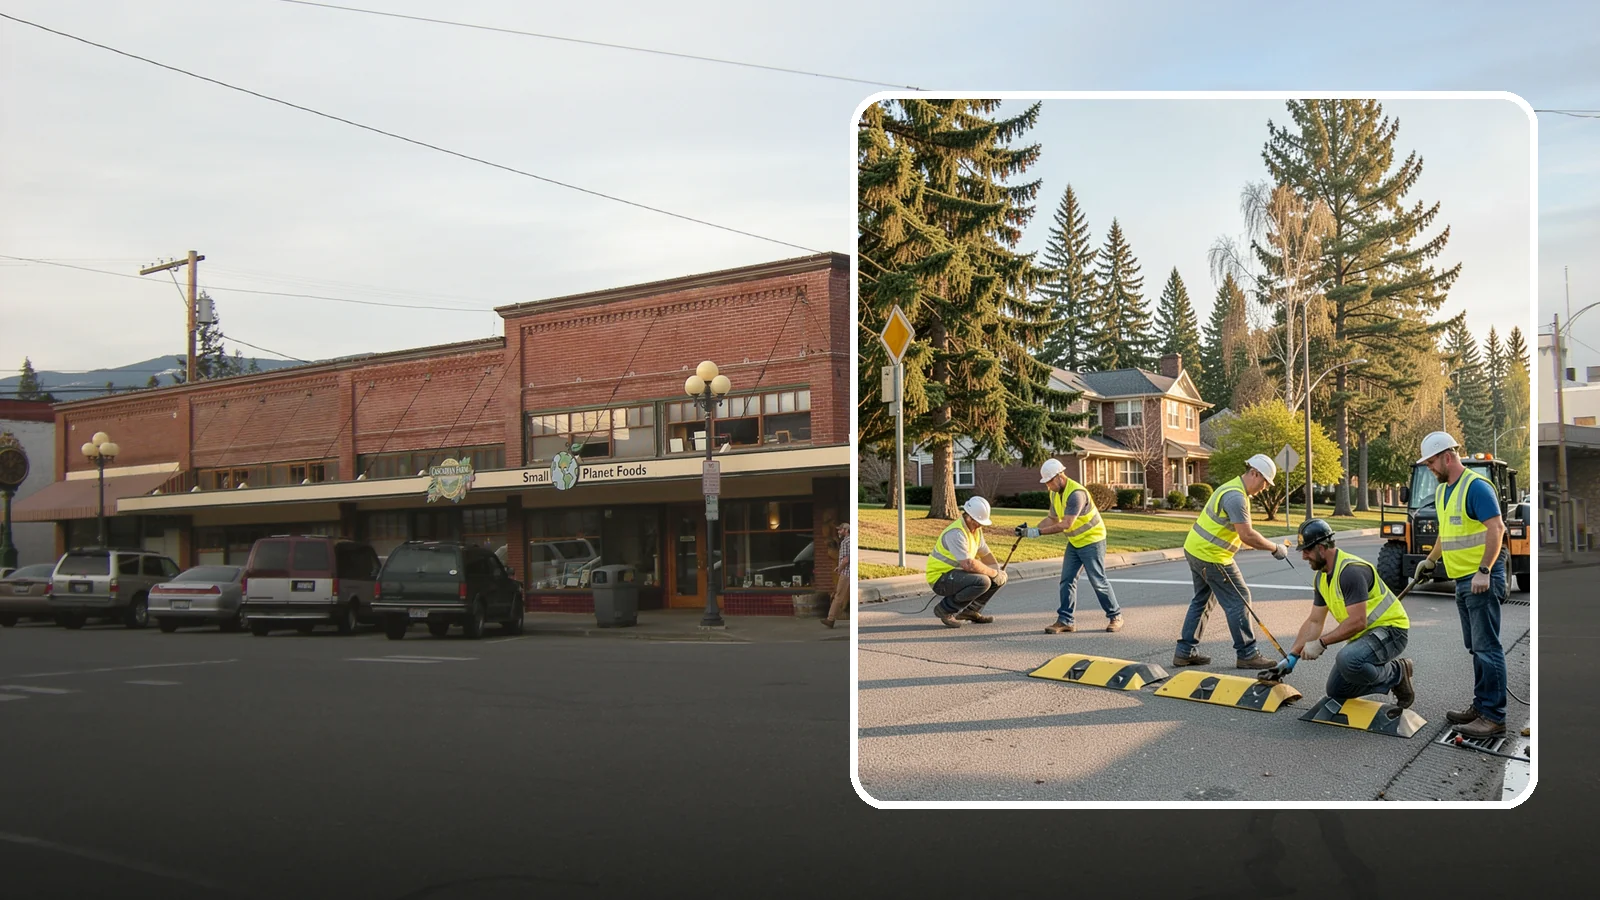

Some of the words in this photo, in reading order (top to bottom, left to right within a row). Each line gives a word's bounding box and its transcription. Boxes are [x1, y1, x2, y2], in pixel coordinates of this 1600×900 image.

[523, 471, 549, 483] Small
[583, 466, 614, 479] Planet
[617, 464, 647, 477] Foods
